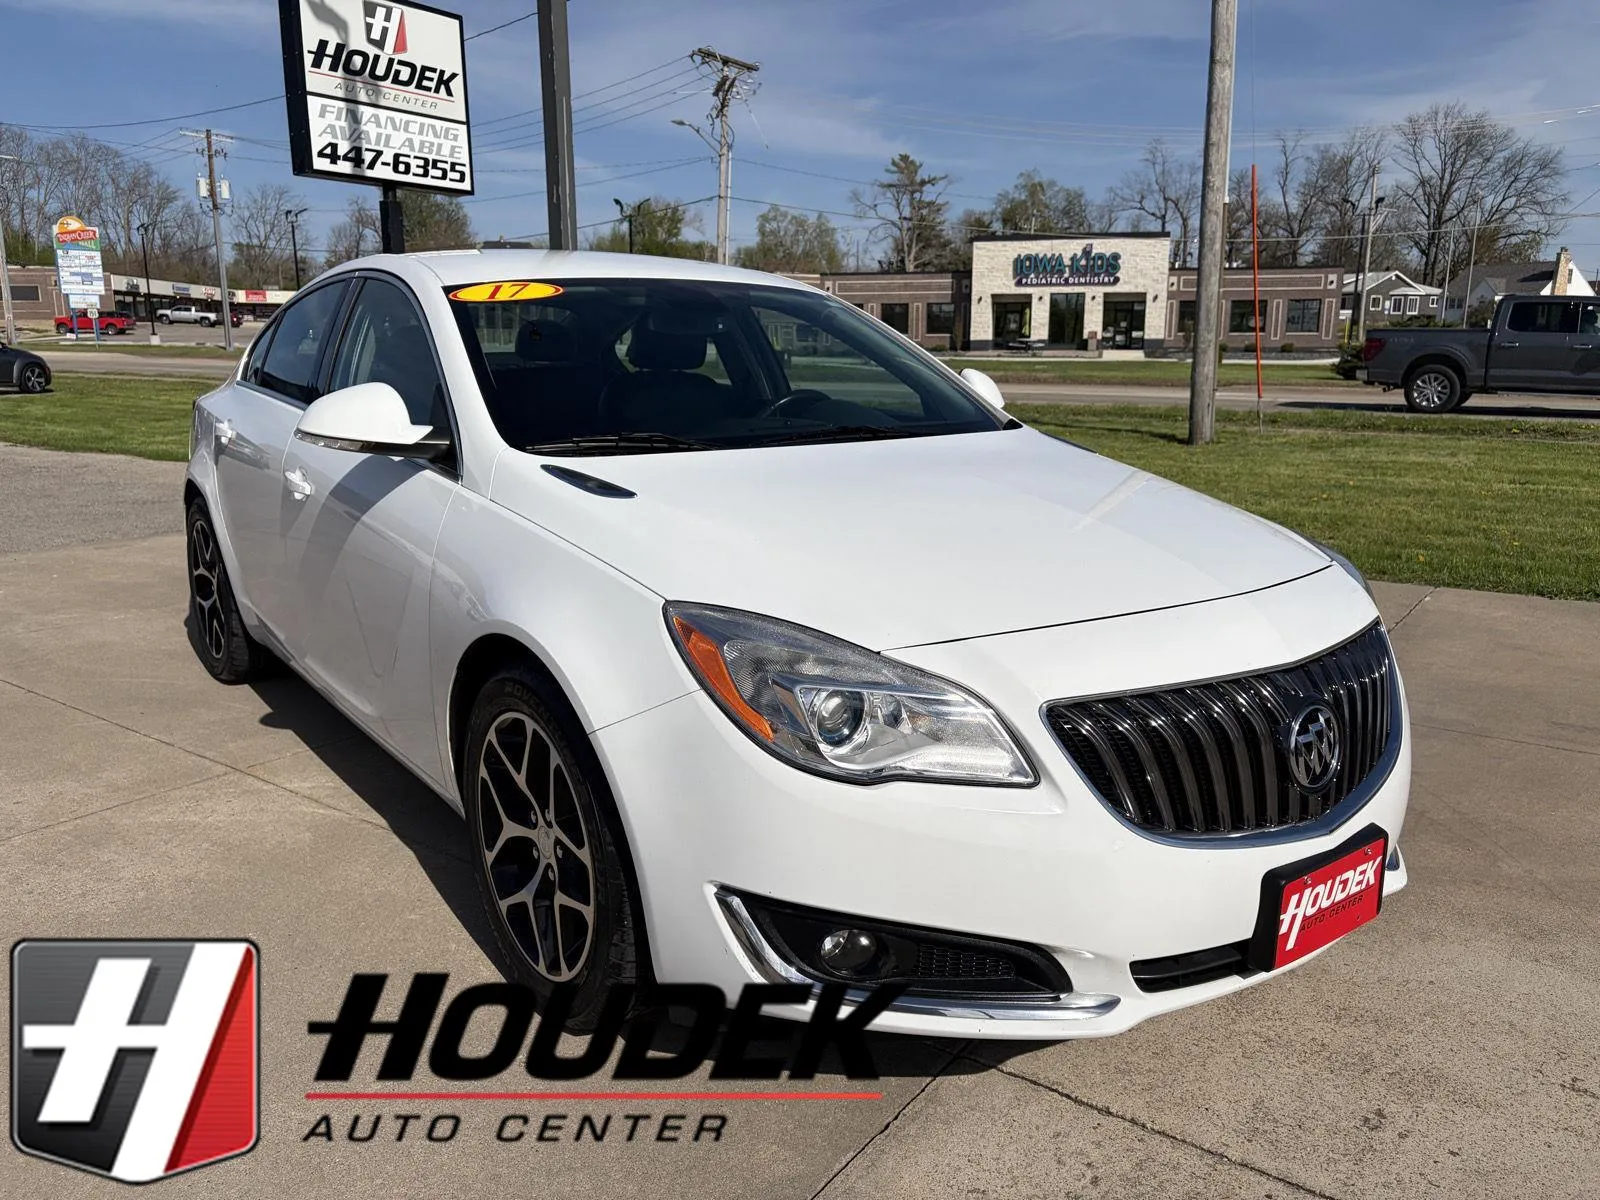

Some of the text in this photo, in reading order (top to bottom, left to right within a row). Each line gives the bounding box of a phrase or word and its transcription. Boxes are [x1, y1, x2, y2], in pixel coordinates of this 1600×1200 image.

[307, 39, 459, 97] HOUDEK
[334, 82, 438, 110] AUTO CENTER
[318, 103, 460, 142] FINANCING
[318, 123, 463, 160] AVAILABLE
[317, 142, 467, 184] 447-6355
[1013, 248, 1121, 275] IOWA KIDS
[1021, 275, 1115, 285] PEDIATRIC DENTISTRY
[482, 283, 530, 300] 17
[1278, 856, 1382, 951] HOUDEK
[1300, 894, 1364, 933] AUTO CENTER
